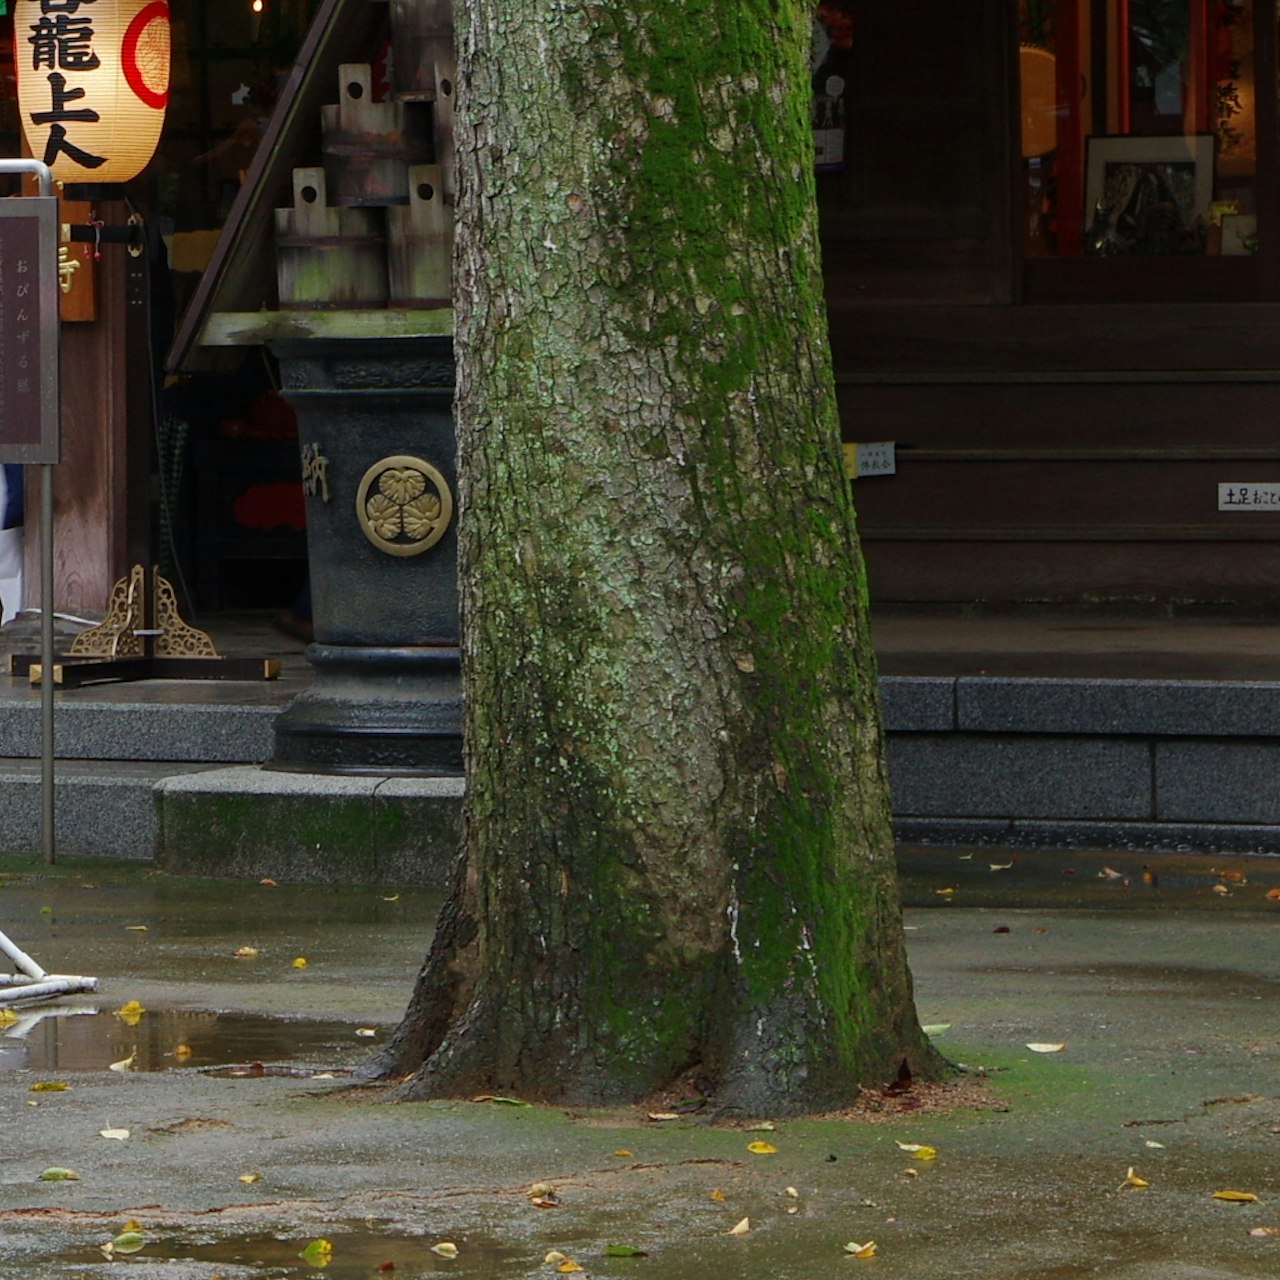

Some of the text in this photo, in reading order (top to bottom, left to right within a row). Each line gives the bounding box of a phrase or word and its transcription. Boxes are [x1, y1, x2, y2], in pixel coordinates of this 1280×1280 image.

[16, 260, 30, 394] おびんずる様
[301, 441, 330, 504] 納
[1223, 487, 1280, 505] 土足おこと
